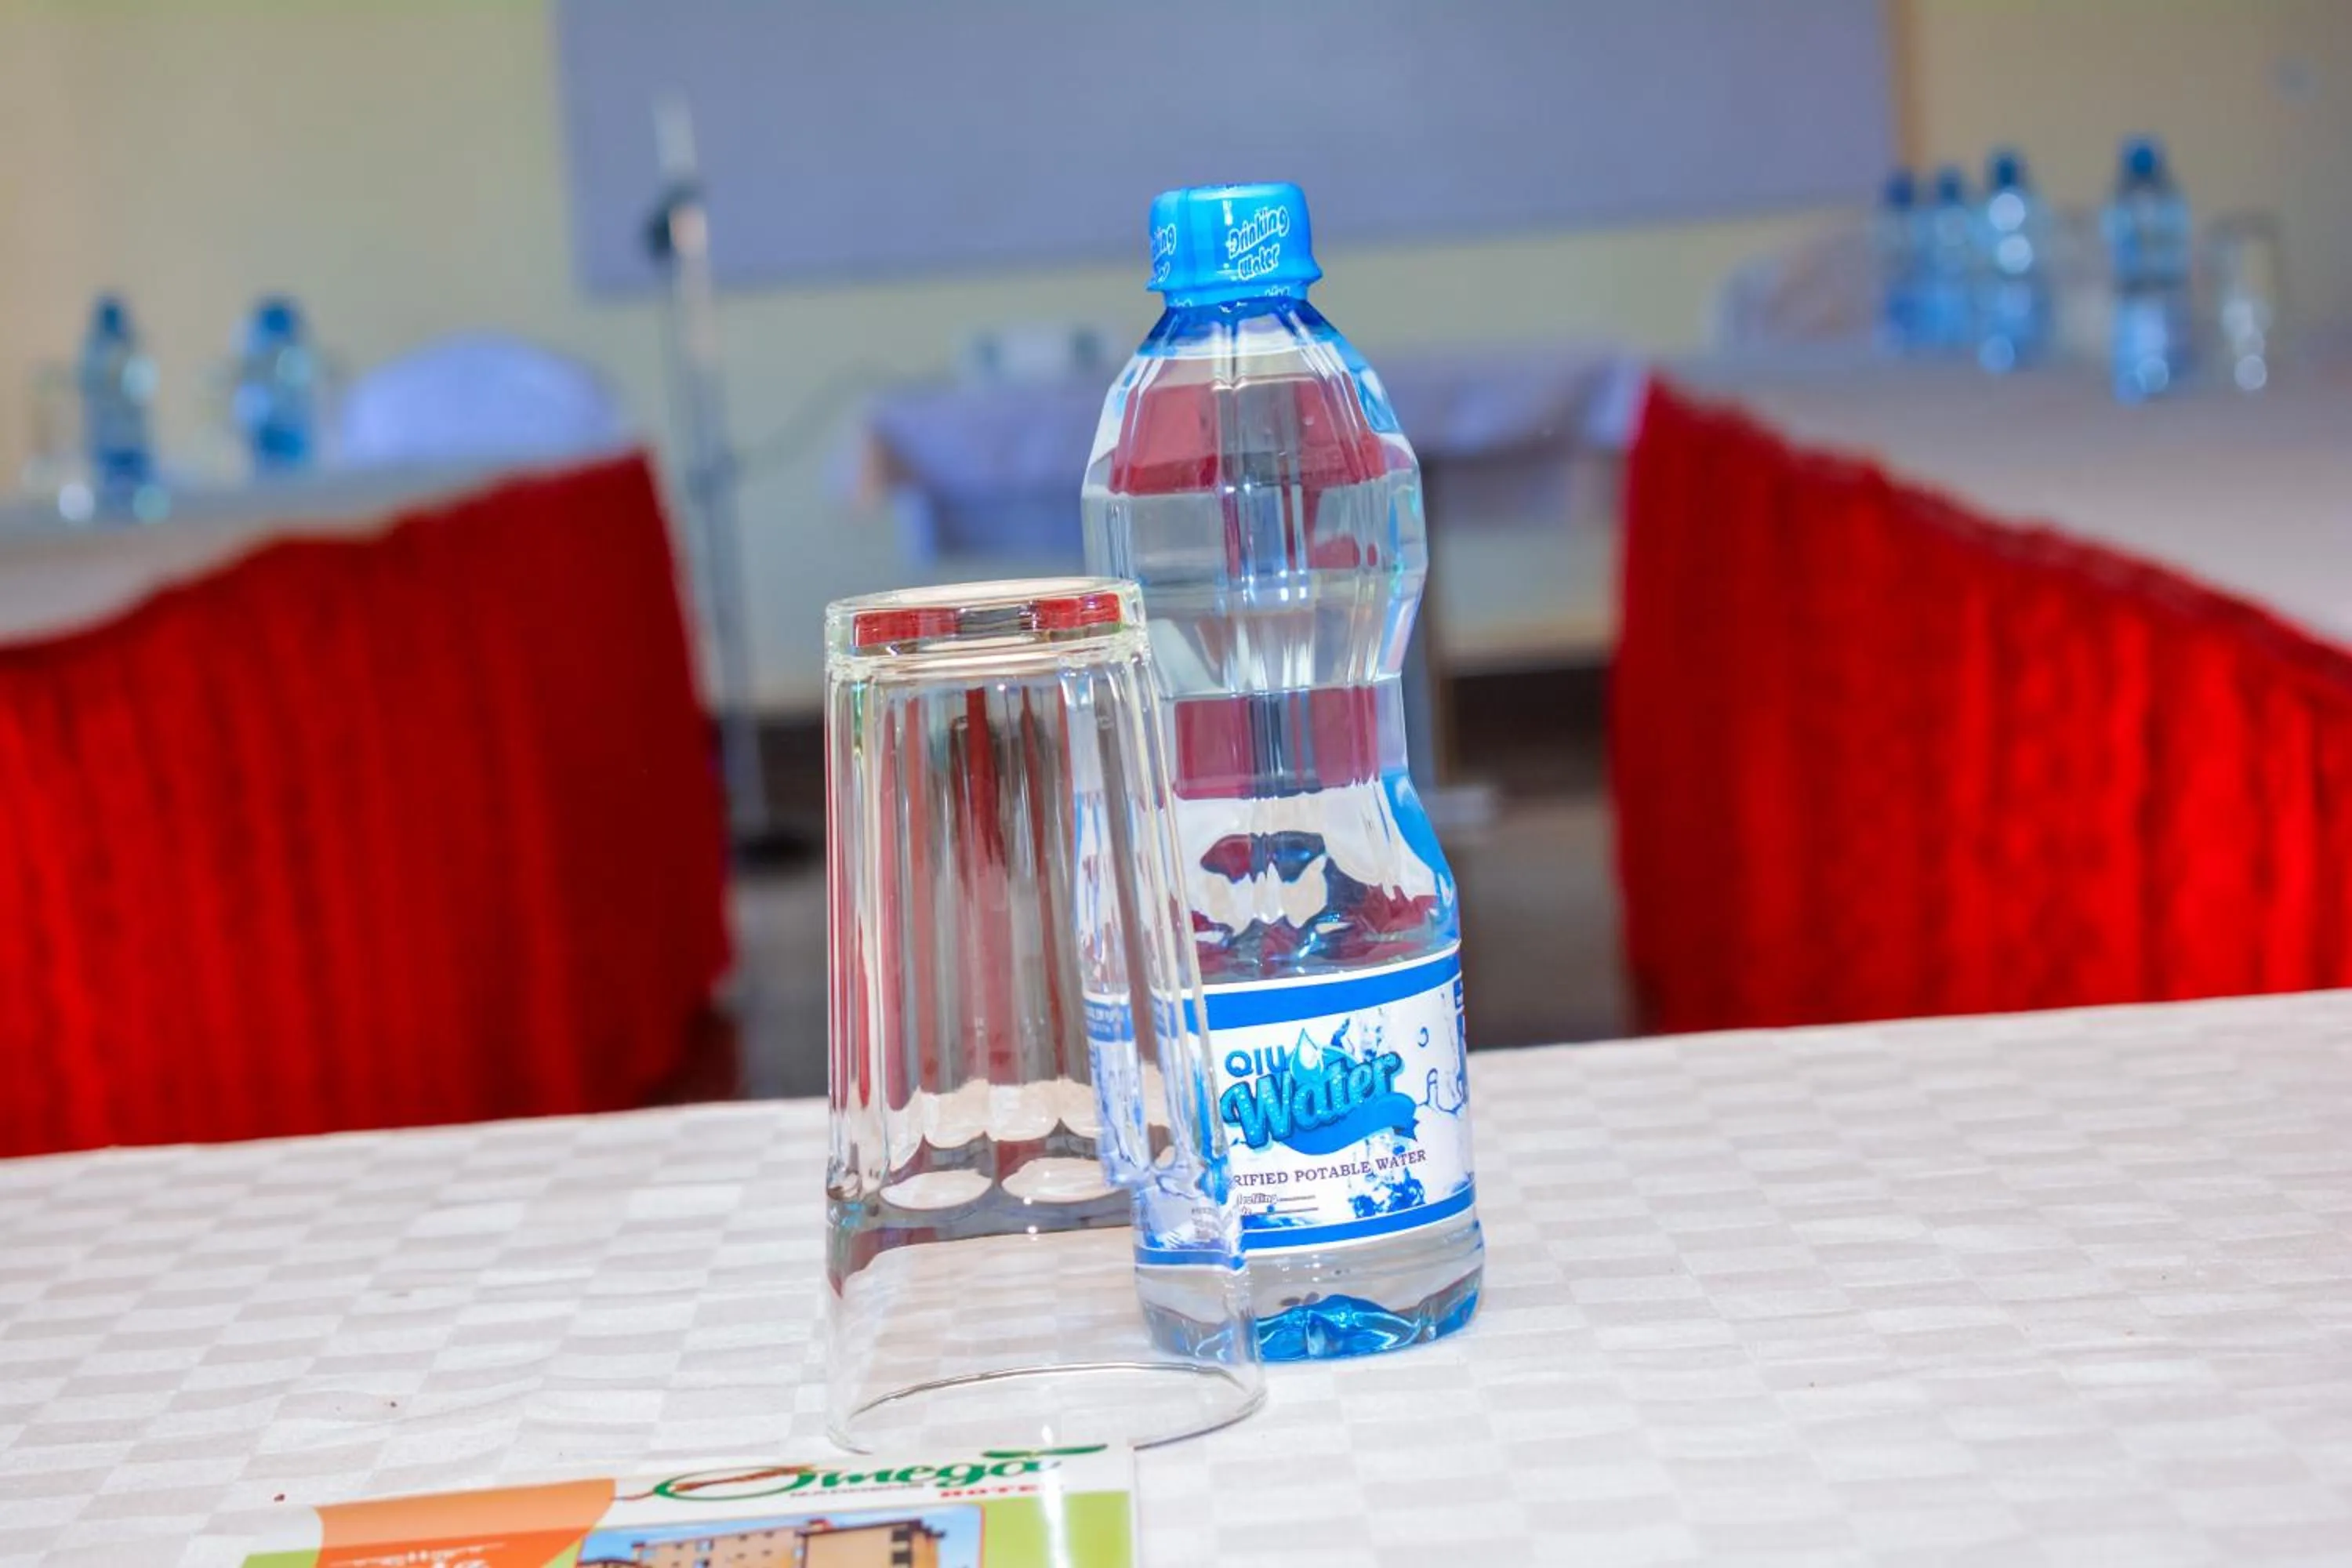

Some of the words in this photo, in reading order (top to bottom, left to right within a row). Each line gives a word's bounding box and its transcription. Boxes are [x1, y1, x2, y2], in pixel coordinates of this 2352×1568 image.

[1227, 205, 1290, 260] Drinking
[1239, 244, 1279, 281] Water
[1225, 1044, 1292, 1078] QIU
[1219, 1051, 1403, 1149] Water
[1234, 1171, 1288, 1187] RIFIED
[1294, 1160, 1371, 1182] POTABLE
[1374, 1149, 1427, 1171] WATER
[653, 1456, 1063, 1501] Omega
[940, 1483, 1041, 1497] HOTE
